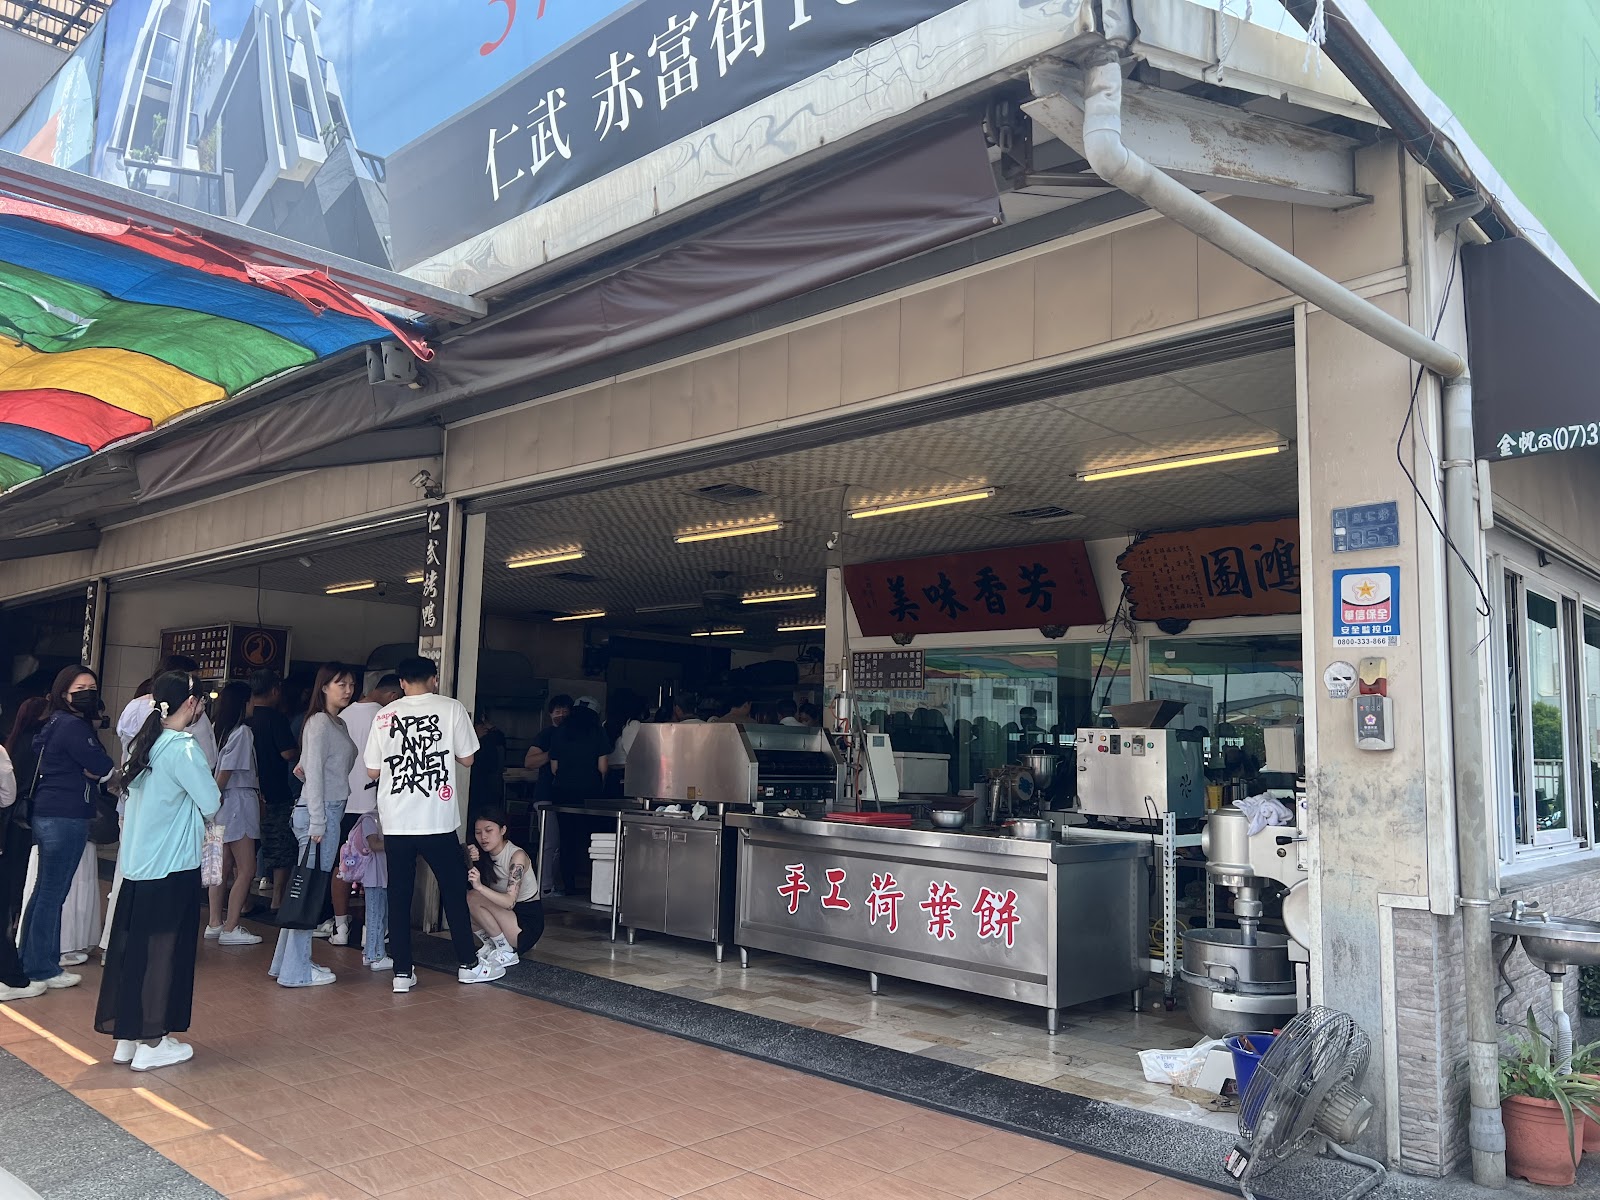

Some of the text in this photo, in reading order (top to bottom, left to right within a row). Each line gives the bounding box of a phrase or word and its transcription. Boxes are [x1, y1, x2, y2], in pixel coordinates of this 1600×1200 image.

[485, 87, 572, 202] 仁武
[592, 0, 766, 142] 赤富街
[1553, 421, 1600, 451] (07)3
[421, 509, 442, 629] 仁武烤鴨
[1344, 607, 1389, 622] 華信保全
[1337, 637, 1386, 646] 0800-333-866
[1340, 624, 1393, 636] 安全監控中
[389, 714, 440, 738] APES
[401, 735, 434, 755] AND
[390, 769, 449, 798] EARTH
[776, 863, 1022, 949] 手工荷葉餅
